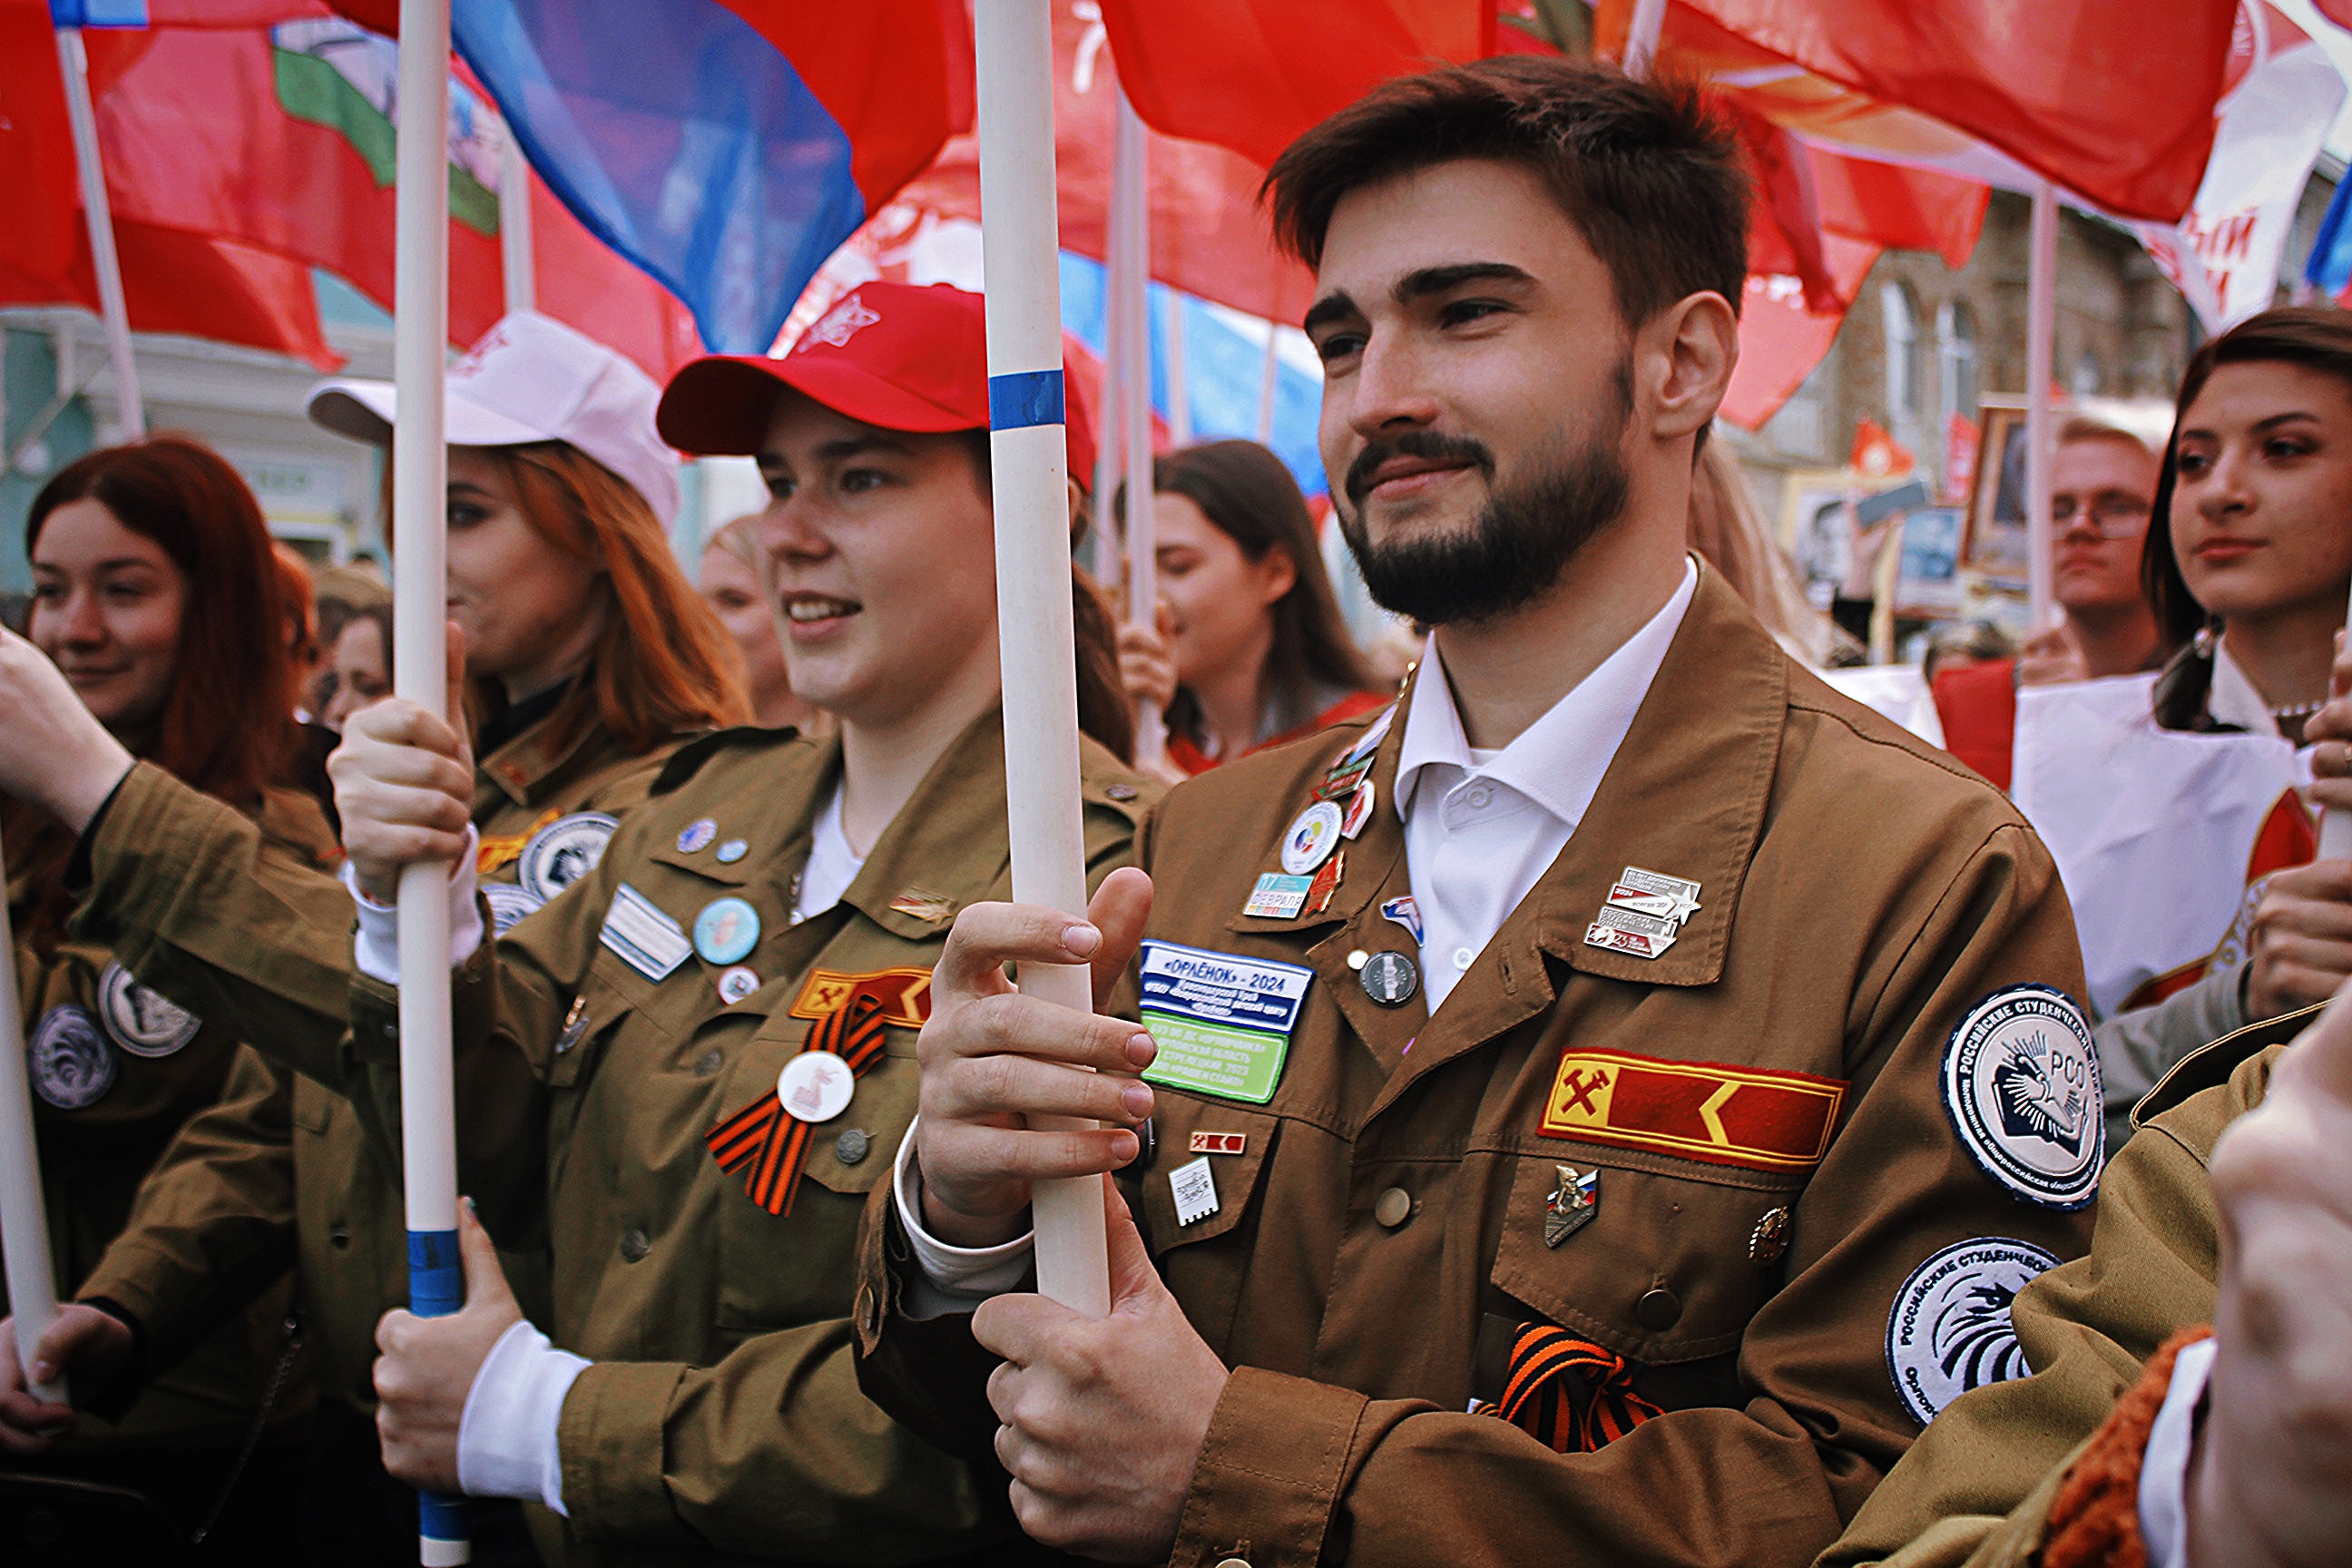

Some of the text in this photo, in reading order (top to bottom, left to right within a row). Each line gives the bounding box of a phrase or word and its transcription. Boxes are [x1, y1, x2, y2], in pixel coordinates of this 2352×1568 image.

[1261, 873, 1279, 890] 17
[1251, 893, 1303, 907] ФЕВРАЛЯ
[1249, 973, 1287, 995] 2024
[1958, 1006, 2014, 1075] РОССИЙСКИЕ
[2051, 1049, 2087, 1091] РСО
[1900, 1250, 2051, 1347] РОССИЙСКИЕ СТУДЕНЧЕСК
